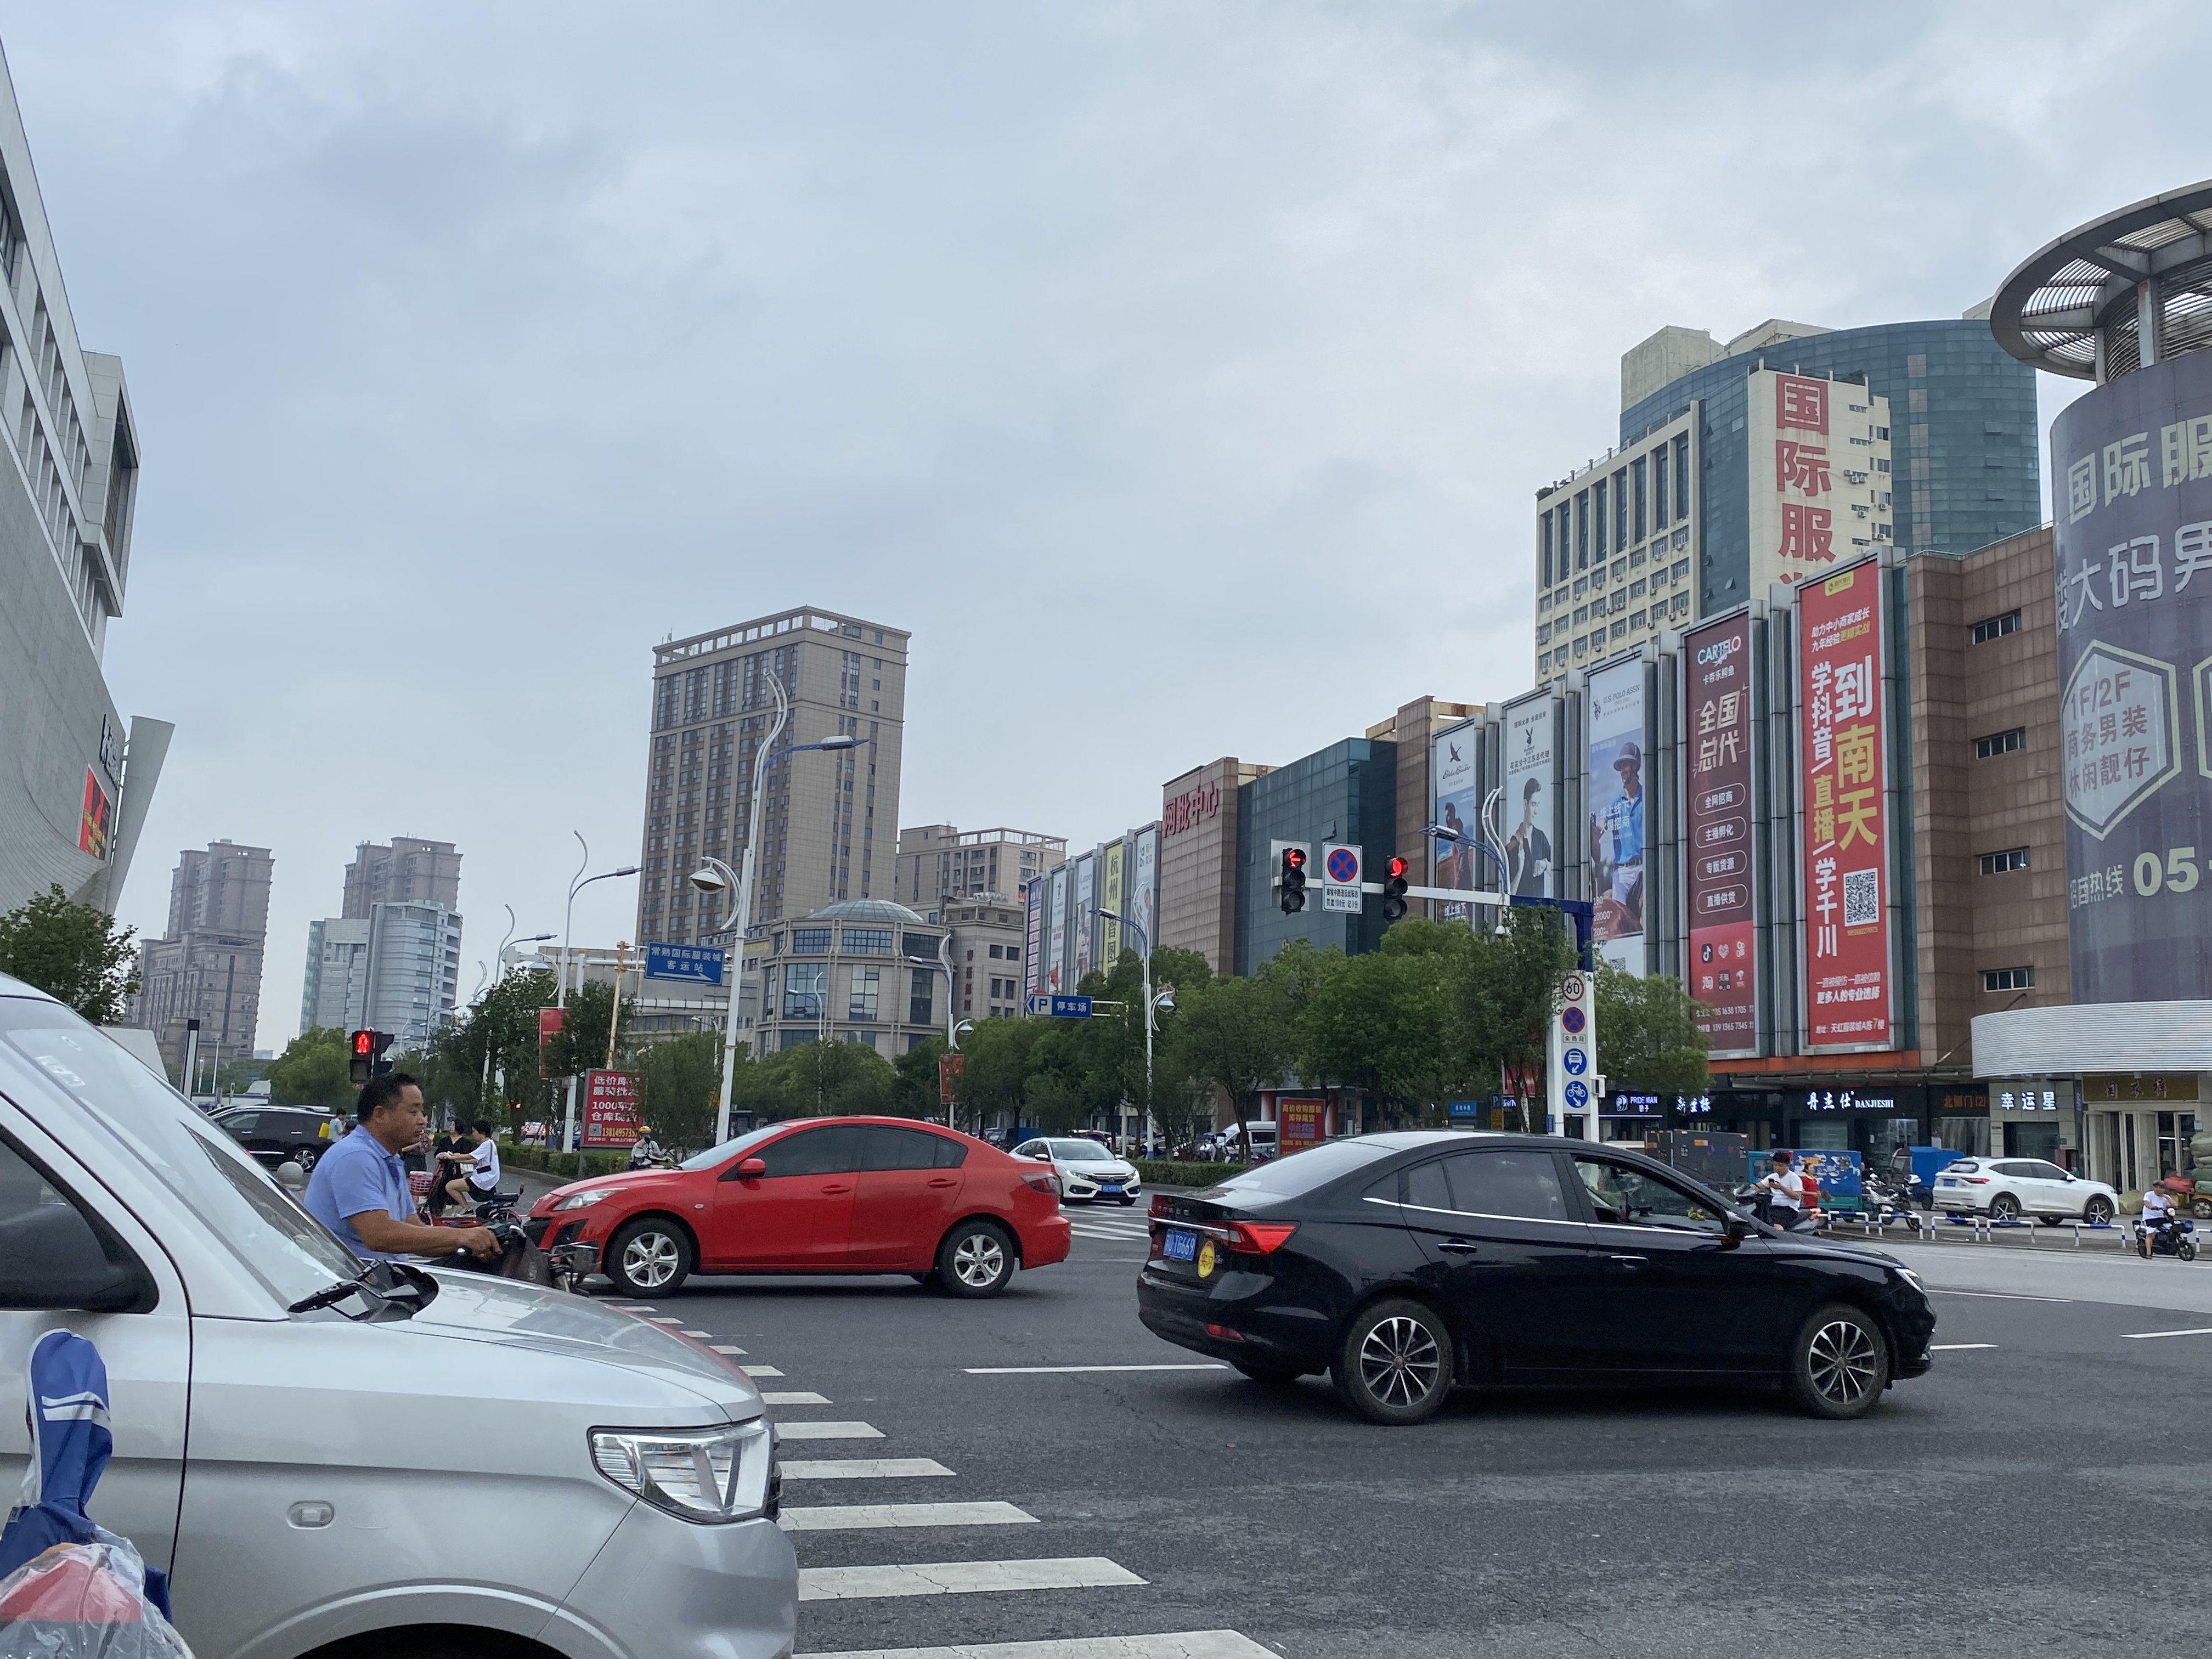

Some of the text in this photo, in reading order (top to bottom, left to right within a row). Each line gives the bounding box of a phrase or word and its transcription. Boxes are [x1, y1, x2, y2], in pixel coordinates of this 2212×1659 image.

[1776, 374, 1836, 584] 国际服
[2069, 415, 2212, 524] 国际服
[1697, 635, 1741, 665] CARTELO
[1613, 690, 1626, 700] POLO
[1698, 690, 1740, 735] 全国
[2072, 670, 2131, 721] 1F/2F
[1698, 730, 1740, 772] 总代
[1835, 655, 1878, 851] 到南天
[2068, 705, 2147, 761] 商务男装
[2070, 747, 2150, 799] 休闲靓仔
[1164, 781, 1219, 838] 网批中心
[2134, 847, 2212, 896] 05
[651, 946, 721, 962] 常熟国际服装城
[667, 960, 704, 972] 客运站
[1039, 1000, 1087, 1013] P 停车场
[1566, 983, 1579, 994] 60
[1855, 1099, 1894, 1108] DANJIESHI
[2001, 1091, 2056, 1110] 幸运星
